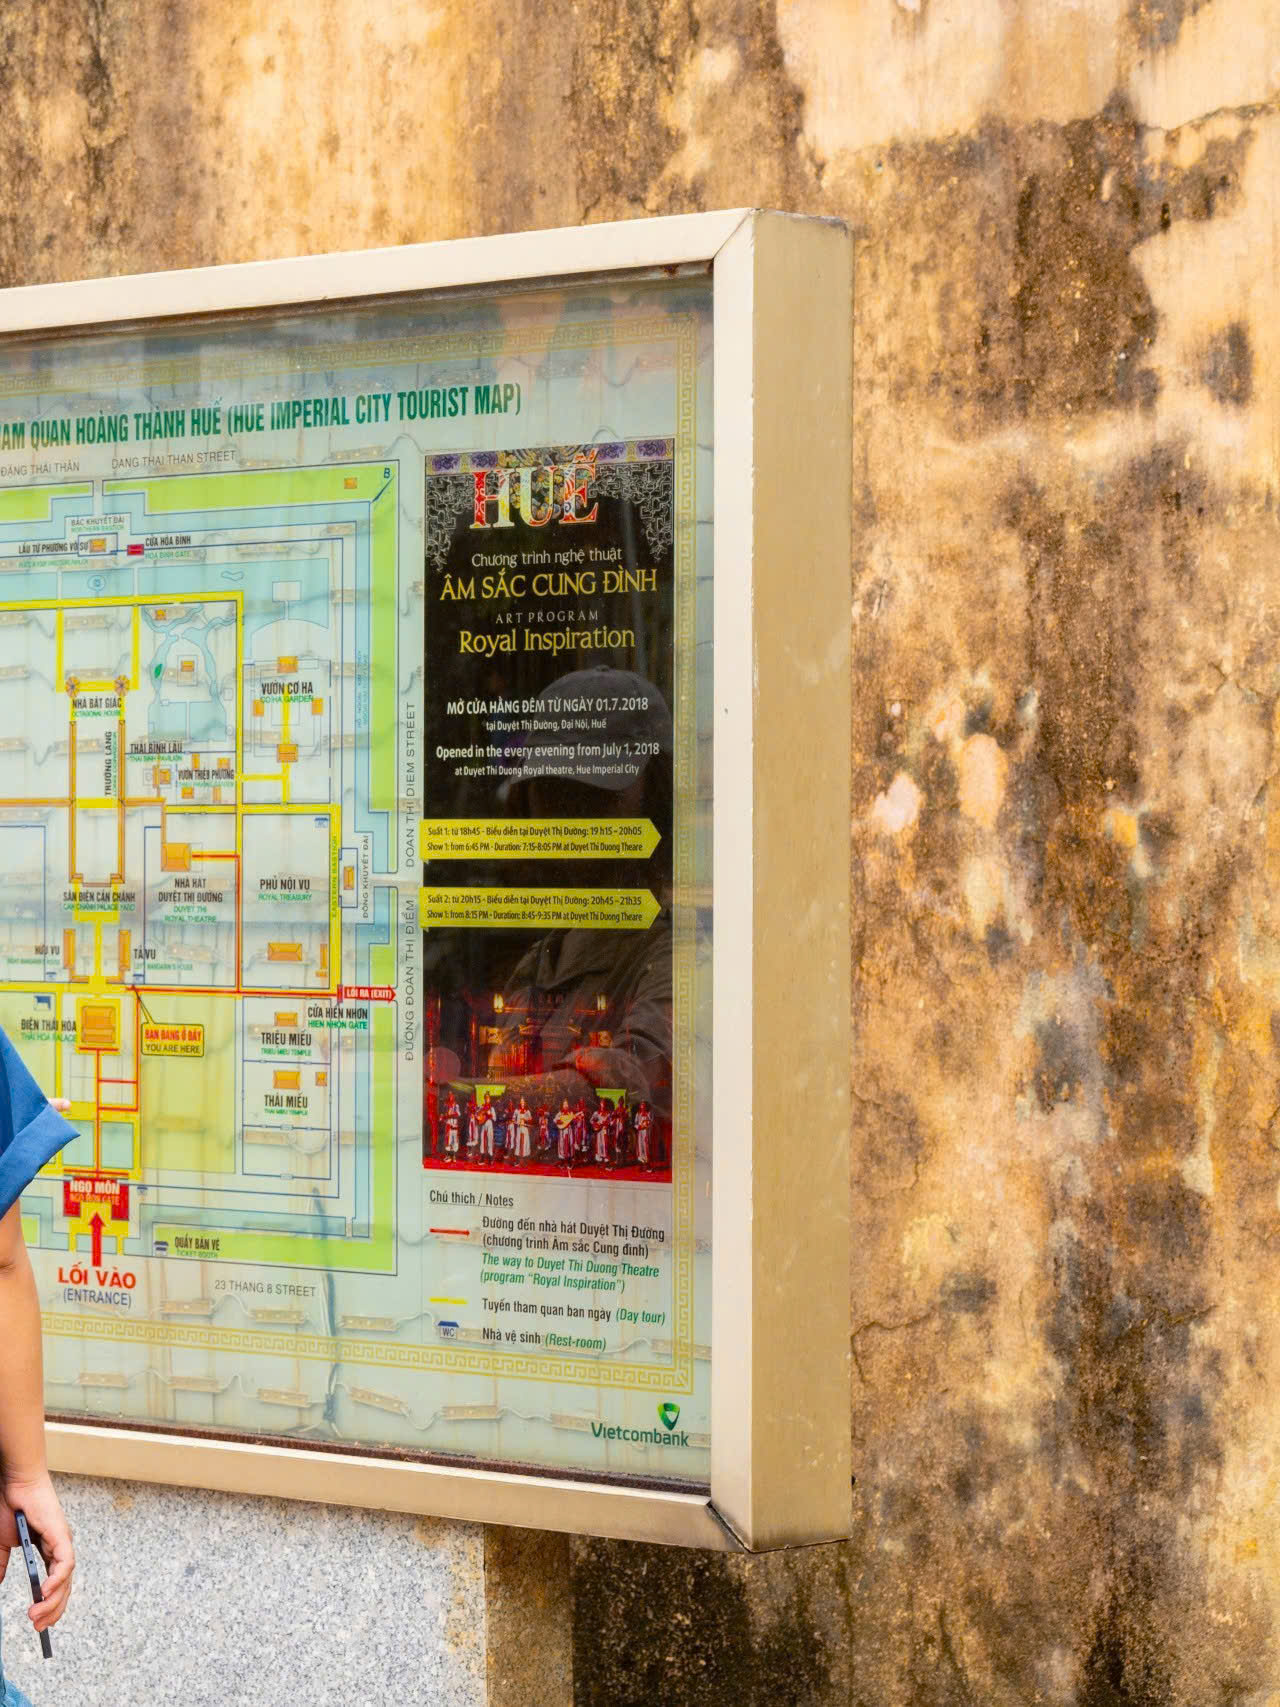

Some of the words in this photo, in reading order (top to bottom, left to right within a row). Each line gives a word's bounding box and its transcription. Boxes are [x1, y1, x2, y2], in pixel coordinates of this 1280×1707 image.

[31, 418, 70, 451] QUAN
[76, 410, 129, 445] HOÀNG
[134, 405, 186, 440] THÀNH
[191, 397, 223, 437] HUẾ
[227, 403, 265, 437] (HUE
[270, 396, 350, 431] IMPERIAL
[356, 393, 392, 425] CITY
[397, 386, 469, 422] TOURIST
[475, 383, 521, 417] MAP)
[112, 455, 139, 469] DANG
[142, 454, 164, 467] THAI
[168, 453, 194, 466] THAN
[197, 450, 236, 464] STREET
[469, 447, 600, 529] HUẾ
[471, 551, 518, 568] Chương
[521, 551, 551, 566] trình
[554, 549, 586, 567] nghệ
[589, 547, 623, 562] thuật
[440, 575, 476, 601] ÂM
[482, 567, 526, 599] SẮC
[532, 572, 597, 597] CUNG
[602, 564, 658, 594] ĐÌNH
[496, 612, 524, 625] ART
[528, 609, 599, 623] PROGRAM
[459, 629, 517, 658] Royal
[524, 625, 636, 657] Inspiration
[522, 697, 546, 713] ĐÊM
[563, 696, 594, 713] NGÀY
[596, 697, 649, 711] 01.7.2018
[405, 702, 416, 758] STREET
[497, 720, 520, 732] Duyệt
[436, 744, 474, 761] Opened
[475, 744, 484, 758] in
[486, 744, 503, 757] the
[504, 746, 533, 760] every
[534, 743, 575, 760] evening
[577, 743, 601, 756] from
[602, 742, 622, 758] July
[624, 743, 632, 757] 1,
[634, 742, 660, 755] 2018
[405, 762, 415, 797] DIEM
[455, 766, 463, 776] at
[463, 765, 486, 778] Duyet
[486, 765, 498, 776] Thi
[498, 765, 522, 778] Duong
[523, 764, 545, 776] Royal
[545, 764, 575, 775] theatre,
[576, 764, 591, 775] Hue
[592, 764, 623, 776] Imperial
[625, 763, 640, 776] City
[405, 802, 415, 824] THI
[405, 828, 415, 868] DOAN
[427, 842, 444, 852] Show
[450, 842, 465, 851] from
[465, 842, 479, 852] 6:45
[480, 842, 490, 851] PM
[494, 841, 521, 852] Duration:
[552, 842, 562, 852] PM
[562, 842, 569, 852] at
[570, 842, 589, 853] Duyet
[590, 842, 599, 852] Thi
[600, 842, 620, 853] Duong
[622, 842, 643, 852] Theare
[145, 1043, 161, 1053] YOU
[163, 1044, 177, 1053] ARE
[180, 1045, 201, 1054] HERE
[429, 1189, 448, 1203] Chú
[486, 1194, 514, 1207] Notes
[482, 1216, 514, 1232] Đường
[517, 1216, 536, 1229] đến
[539, 1219, 557, 1232] nhà
[560, 1220, 577, 1233] hát
[580, 1222, 609, 1240] Duyệt
[612, 1225, 628, 1240] Thị
[631, 1226, 665, 1242] Đường
[483, 1233, 523, 1250] (chương
[593, 1241, 619, 1257] Cung
[58, 1261, 89, 1286] LỐI
[96, 1266, 137, 1290] VÀO
[482, 1252, 499, 1266] The
[502, 1256, 521, 1268] way
[524, 1256, 534, 1267] to
[537, 1256, 565, 1271] Duyet
[568, 1258, 584, 1270] Thi
[586, 1260, 618, 1277] Duong
[621, 1262, 659, 1277] Theatre
[480, 1269, 525, 1285] (program
[63, 1288, 132, 1309] (ENTRANCE)
[214, 1280, 226, 1290] 23
[229, 1280, 264, 1294] THANG
[266, 1283, 273, 1294] 8
[275, 1284, 317, 1297] STREET
[482, 1298, 511, 1313] Tuyến
[513, 1300, 537, 1314] tham
[540, 1304, 564, 1317] quan
[567, 1304, 585, 1318] ban
[588, 1307, 611, 1322] ngày
[616, 1308, 639, 1324] (Day
[641, 1310, 666, 1326] tour)
[442, 1327, 455, 1338] WC
[482, 1327, 502, 1341] Nhà
[505, 1330, 517, 1344] vệ
[520, 1330, 541, 1344] sinh
[545, 1333, 607, 1351] (Rest-room)
[591, 1420, 689, 1447] Vietcombank
